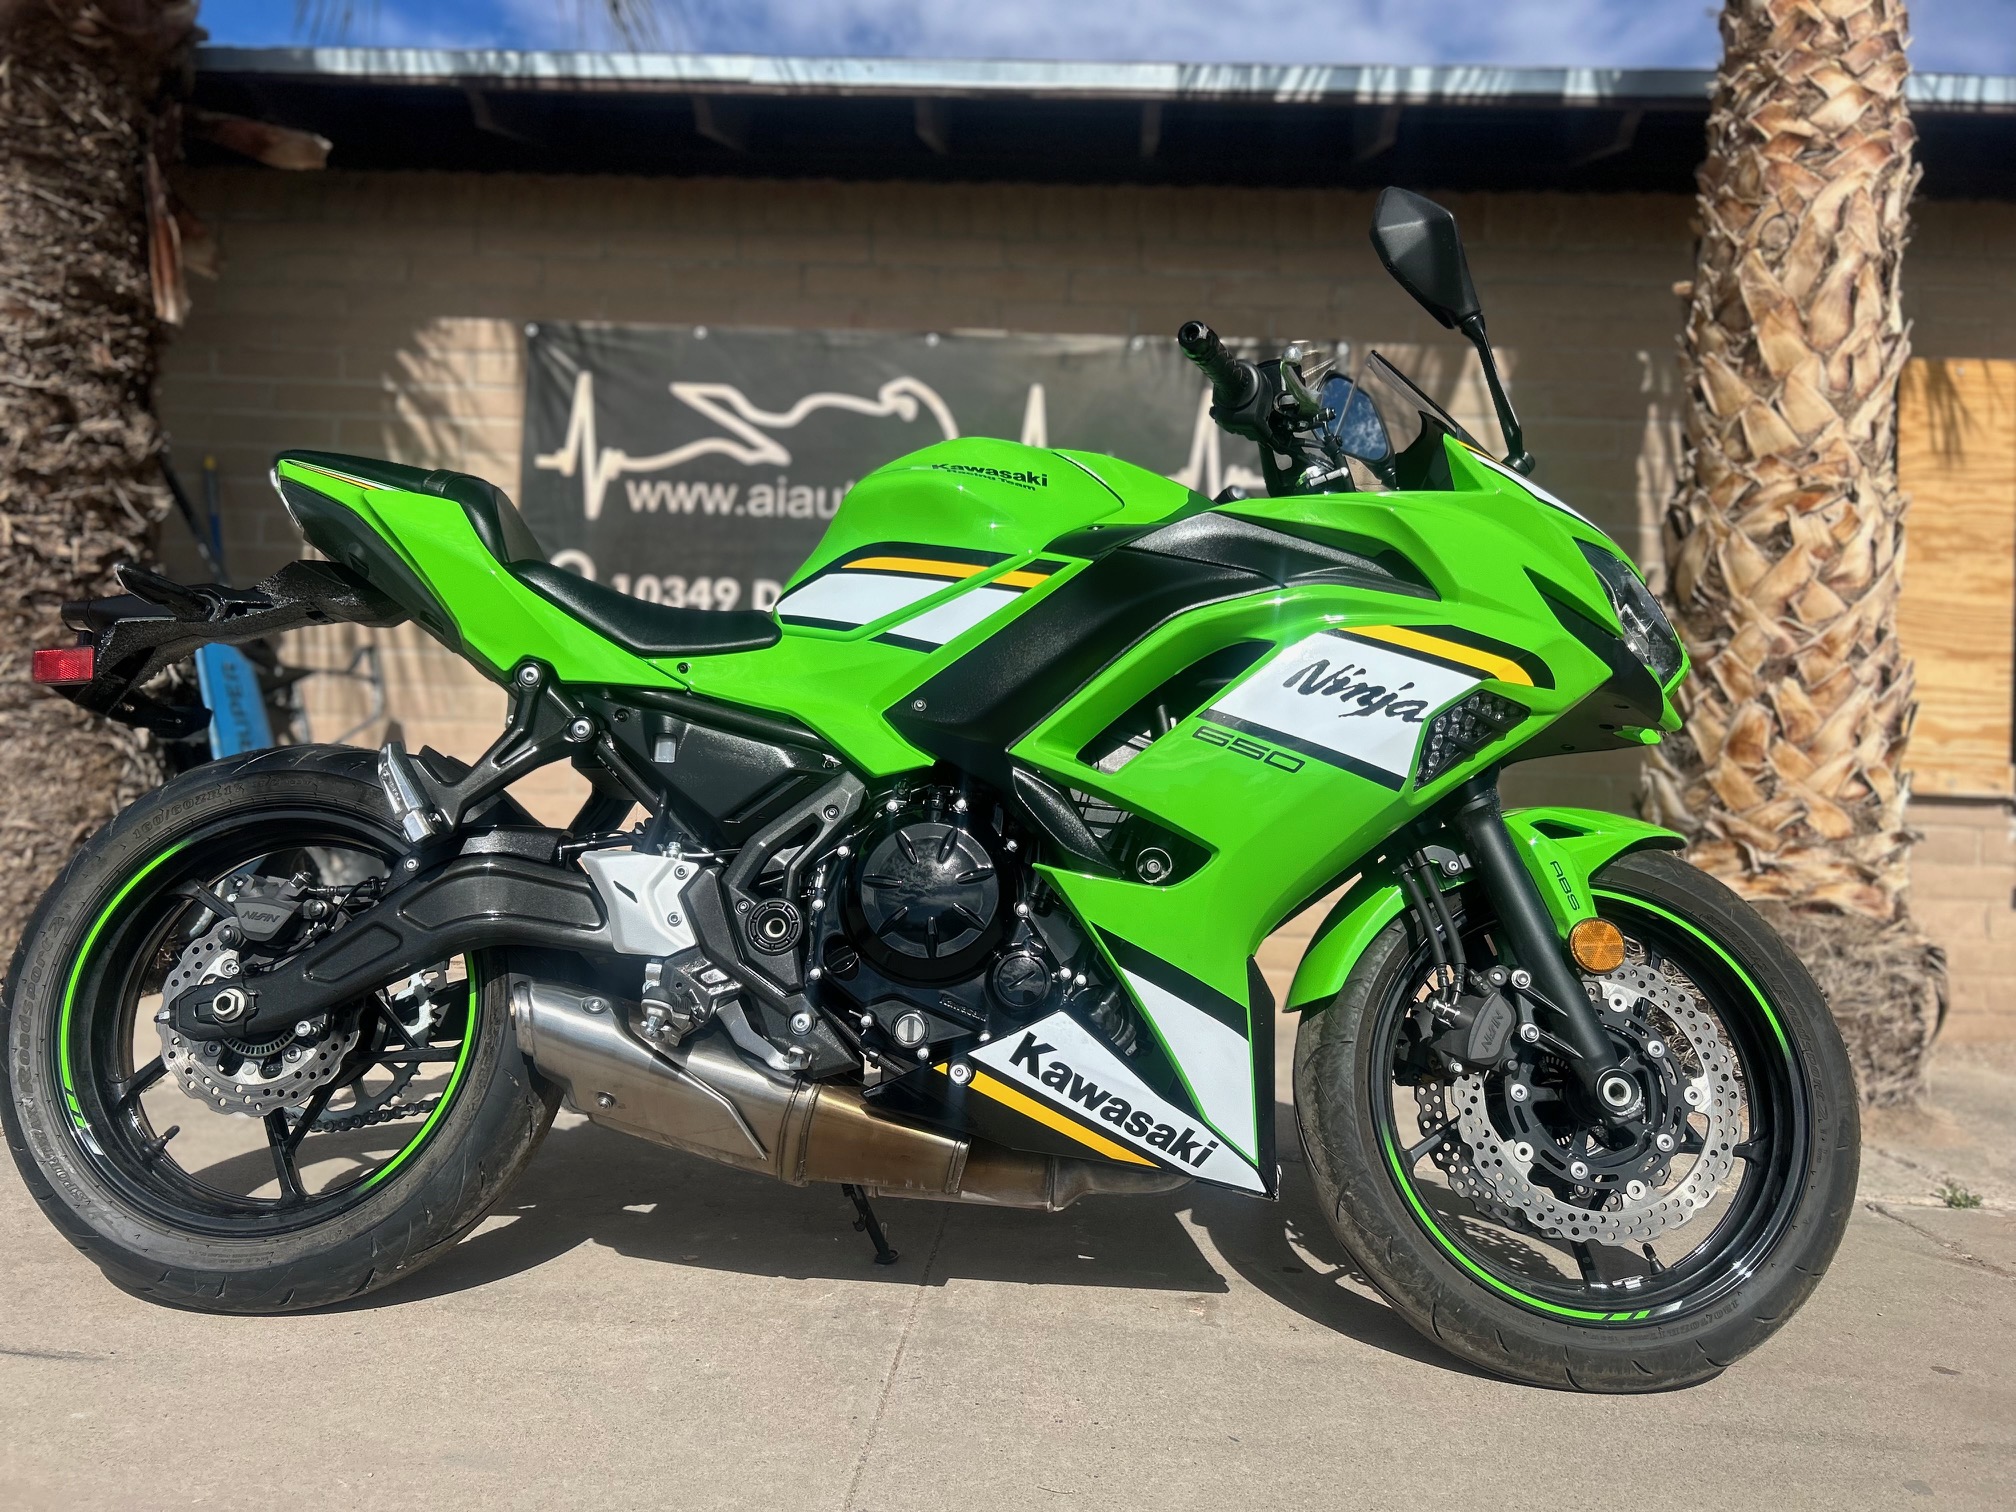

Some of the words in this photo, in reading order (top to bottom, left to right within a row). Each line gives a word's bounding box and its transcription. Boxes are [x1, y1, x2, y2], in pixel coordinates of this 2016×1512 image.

[625, 476, 855, 519] www.aiau
[931, 463, 1048, 487] Kawasaki
[611, 573, 741, 611] 10349
[1283, 659, 1424, 722] Ninja
[1192, 725, 1306, 773] 650
[132, 782, 245, 840] 160/60ZR17
[1549, 860, 1580, 911] ABS
[1008, 1031, 1220, 1168] Kawasaki
